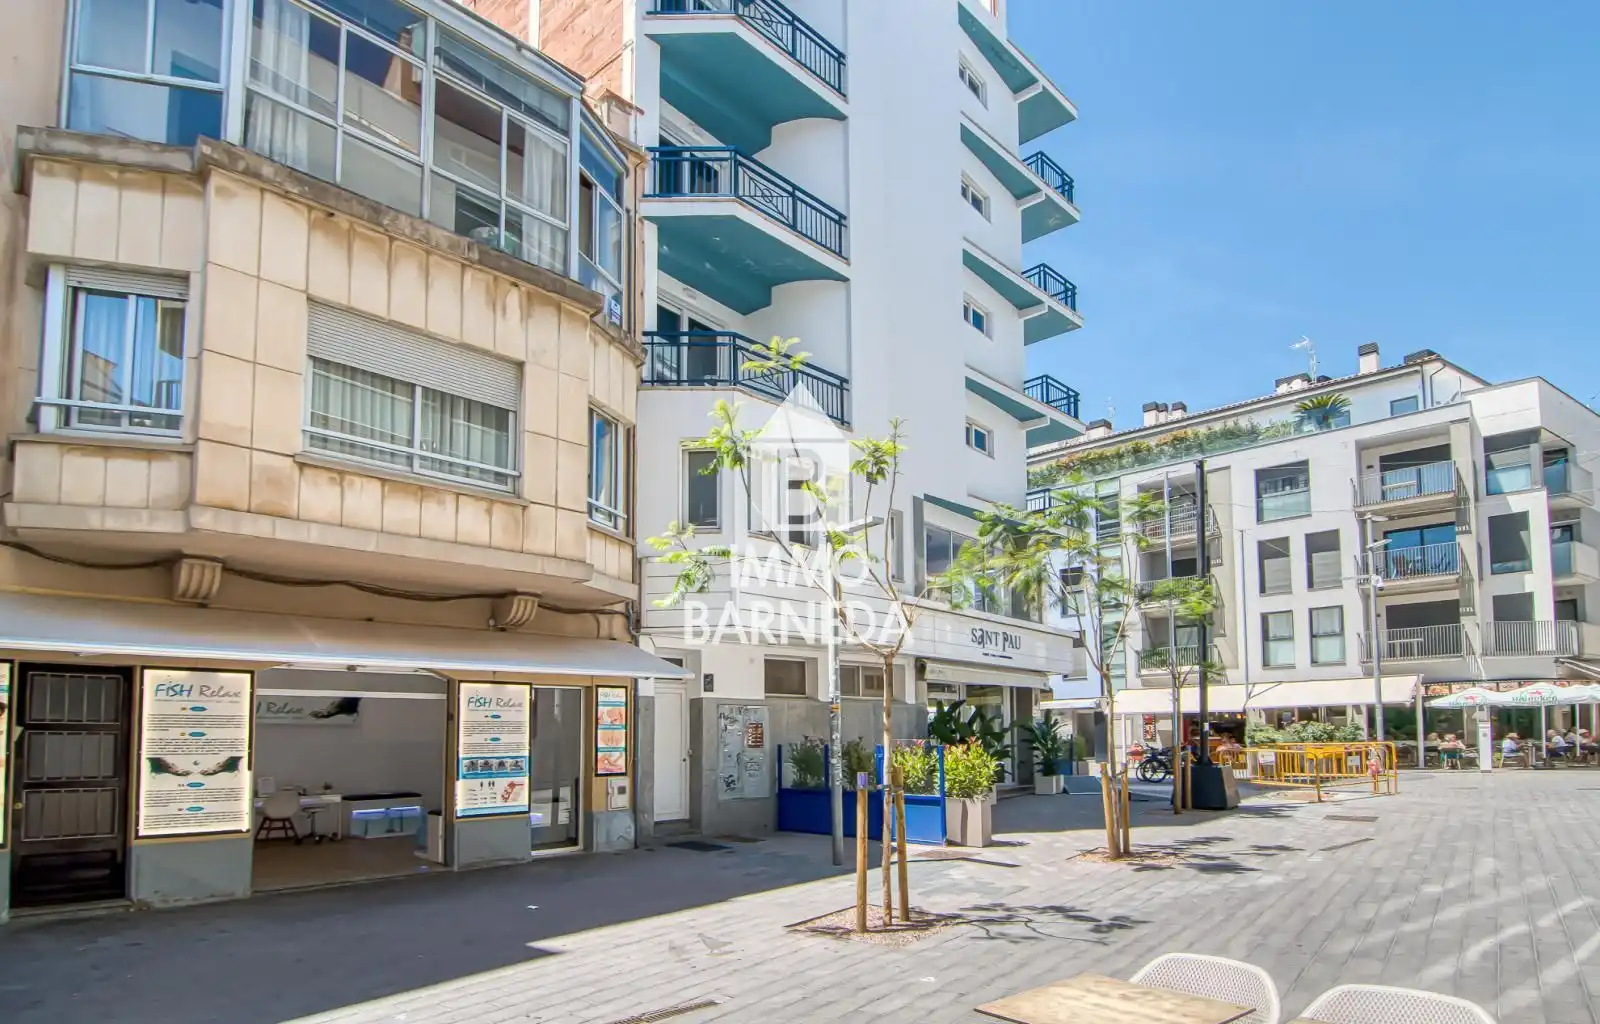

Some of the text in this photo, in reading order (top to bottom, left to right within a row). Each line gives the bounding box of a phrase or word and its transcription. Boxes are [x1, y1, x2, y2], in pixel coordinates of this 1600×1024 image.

[1002, 631, 1021, 652] PAU
[199, 684, 242, 698] Relax
[496, 697, 524, 708] Relax
